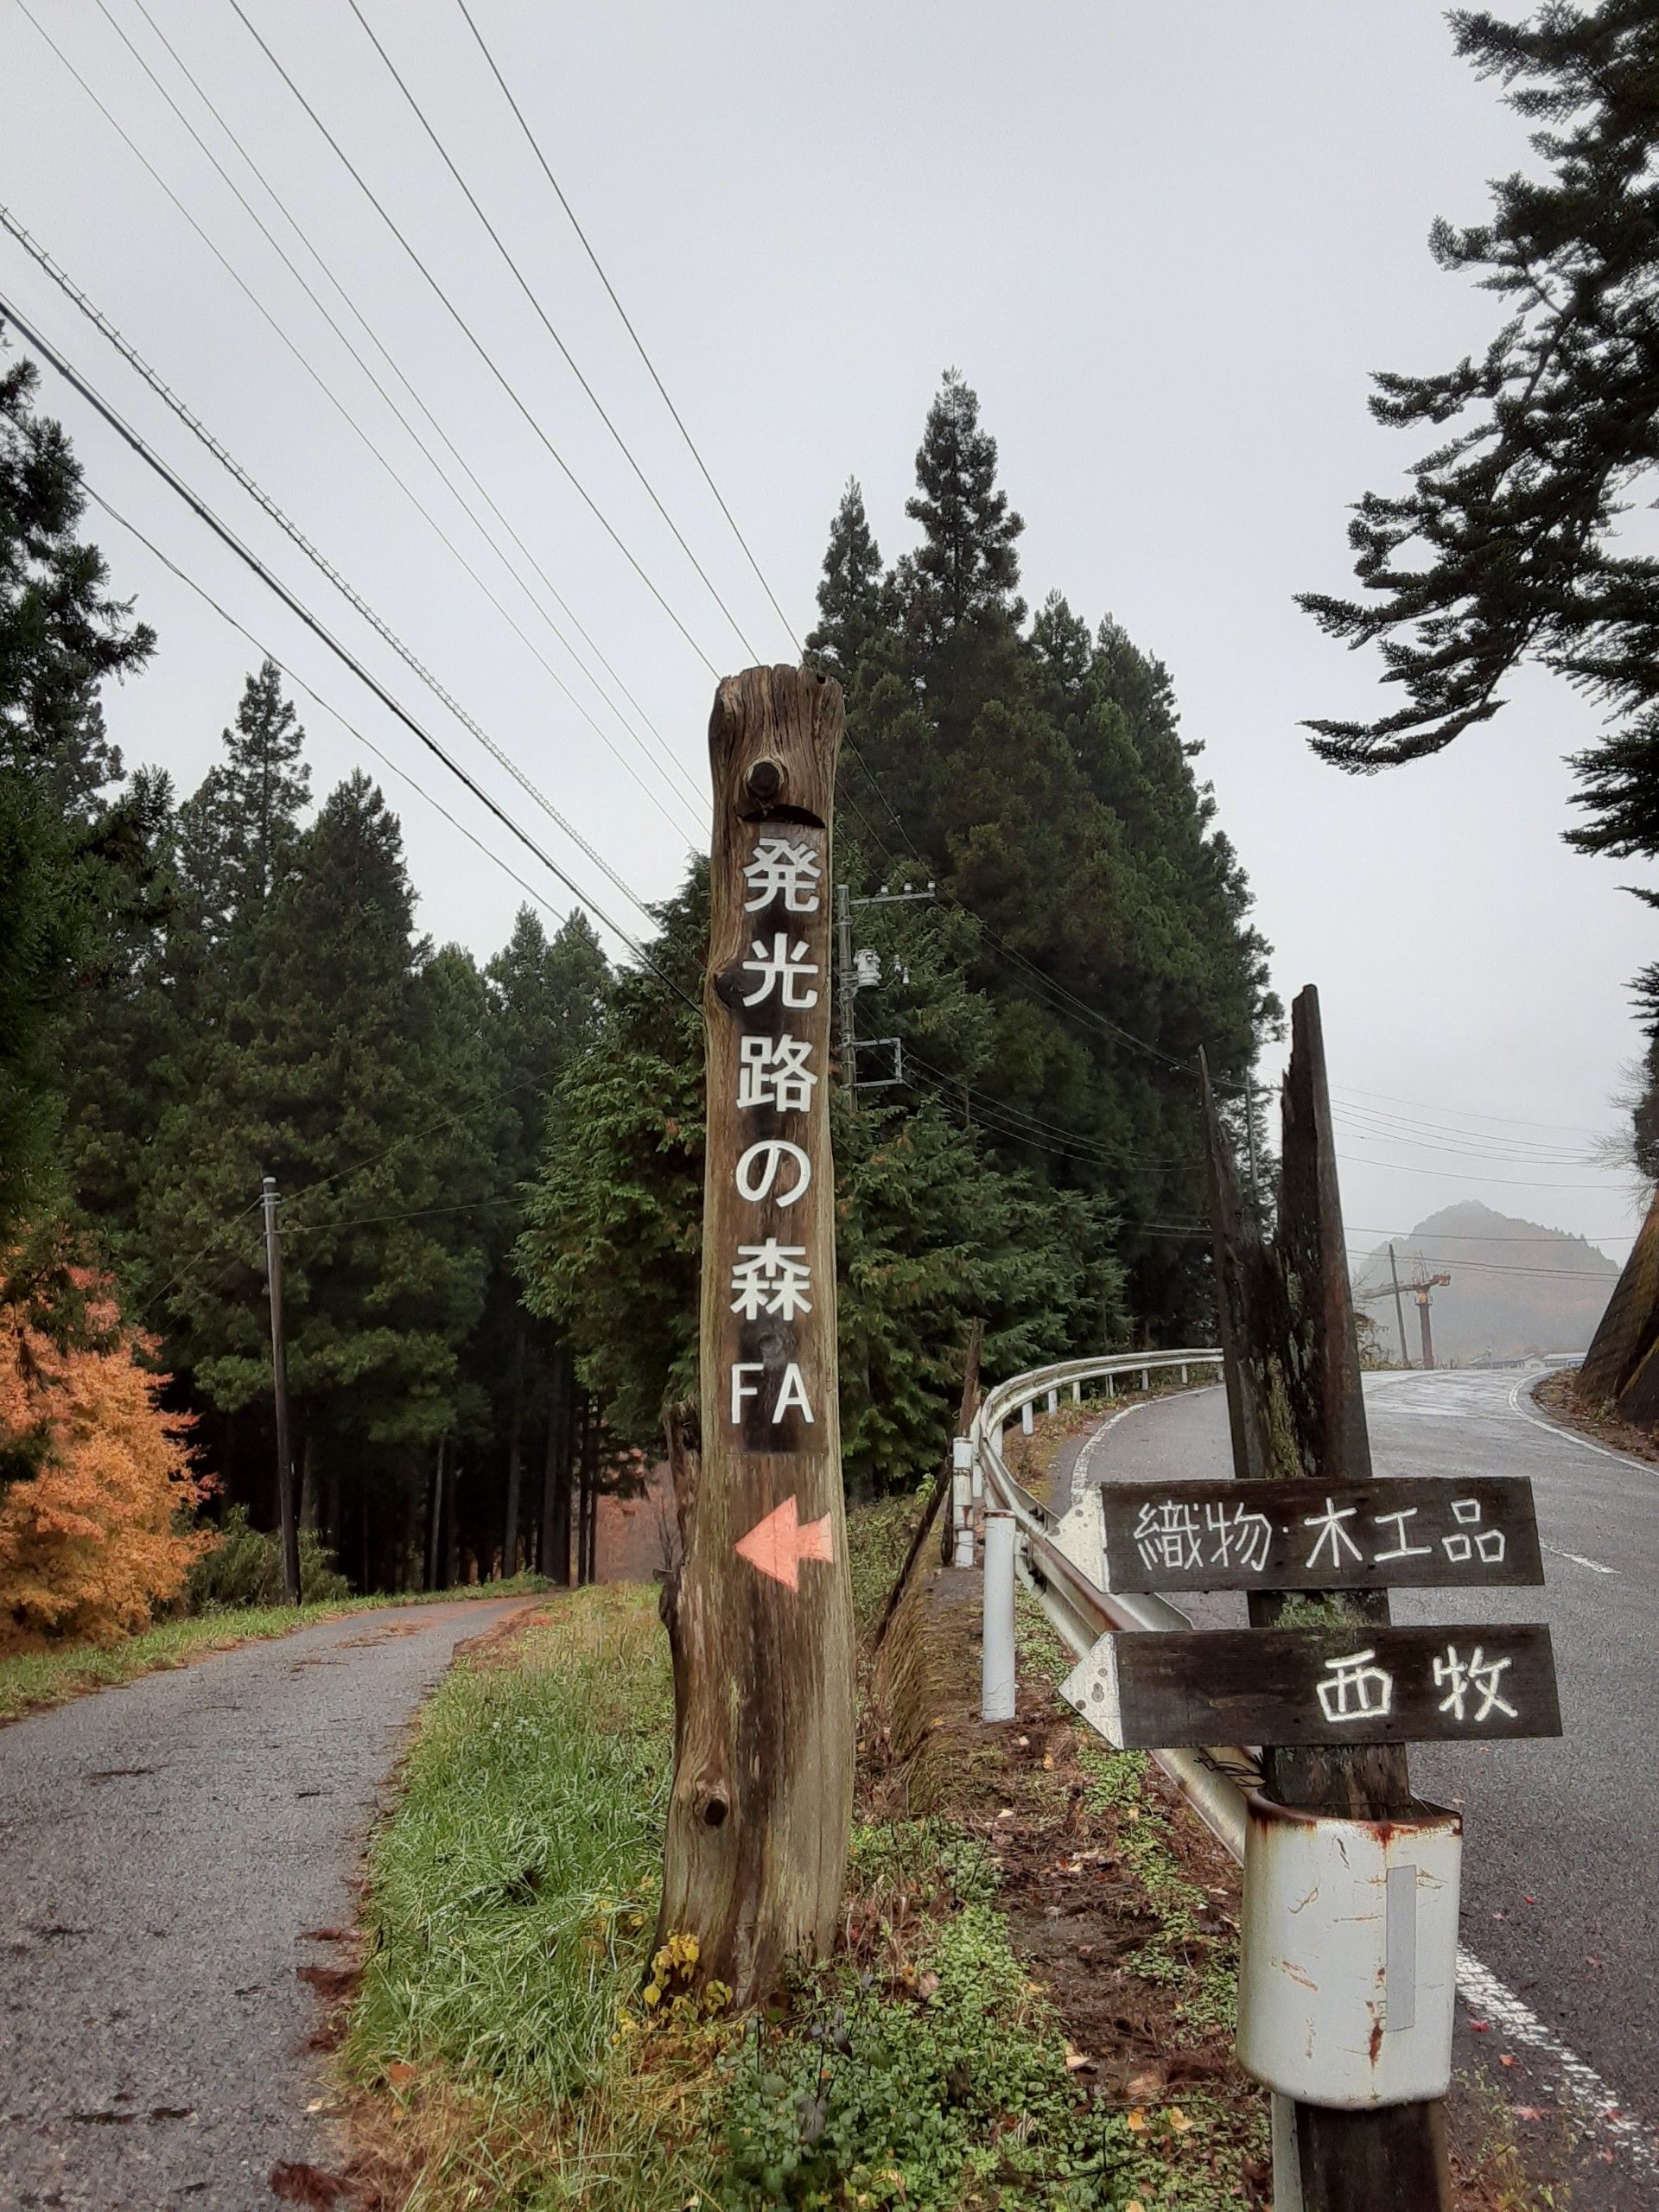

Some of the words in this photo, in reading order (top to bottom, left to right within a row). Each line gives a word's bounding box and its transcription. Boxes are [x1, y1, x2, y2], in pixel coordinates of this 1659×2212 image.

[729, 836, 820, 1322] 発光路の森
[729, 1362, 814, 1425] FA
[1315, 1645, 1519, 1723] 西牧
